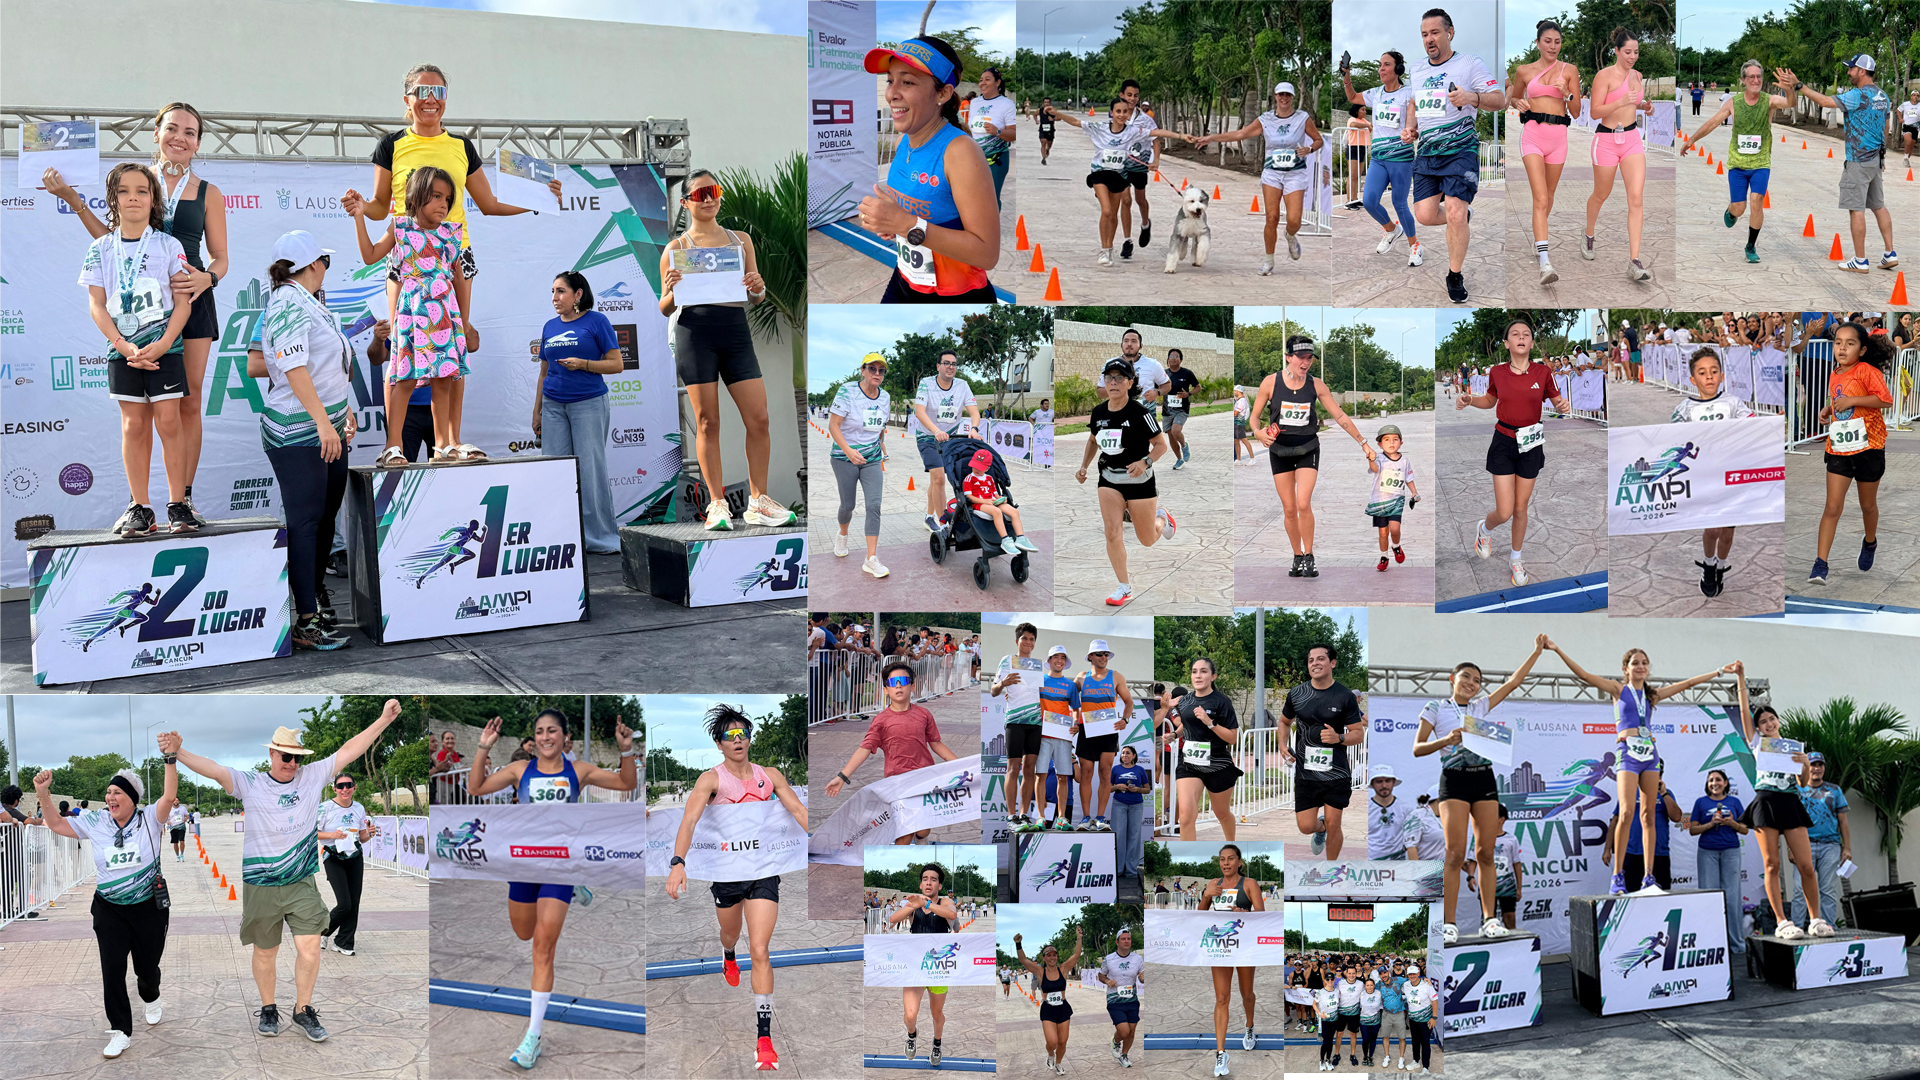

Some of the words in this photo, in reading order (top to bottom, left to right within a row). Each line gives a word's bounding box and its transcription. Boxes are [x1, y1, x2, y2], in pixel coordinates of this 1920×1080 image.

[819, 32, 846, 46] Evalor
[819, 45, 865, 60] Patrimonio
[1419, 98, 1442, 109] 048
[812, 99, 853, 125] 93
[1379, 111, 1396, 121] 047
[55, 127, 69, 147] 2
[818, 128, 852, 139] NOTARÍA
[820, 140, 851, 149] PÚBLICA
[1740, 141, 1758, 150] 258
[1105, 153, 1123, 164] 308
[1276, 153, 1292, 163] 310
[529, 162, 535, 178] 1
[560, 196, 600, 211] LIVE
[705, 253, 717, 270] 3
[132, 291, 153, 313] 21
[79, 355, 107, 365] Evalo
[80, 367, 107, 378] Patri
[81, 379, 107, 389] Inmo
[610, 392, 636, 401] ANCÚN
[867, 417, 883, 426] 316
[1285, 411, 1306, 420] 037
[1522, 431, 1541, 446] 295
[1835, 429, 1860, 443] 301
[1101, 438, 1118, 448] 077
[234, 478, 273, 490] CARRERA
[1386, 477, 1404, 488] 097
[231, 491, 268, 502] INFANTIL
[1615, 479, 1691, 506] AMPI
[230, 501, 253, 511] 500M
[1630, 500, 1677, 513] CANCÚN
[1643, 511, 1665, 520] 2026
[477, 485, 509, 579] 1
[501, 543, 576, 576] LUGAR
[771, 538, 803, 592] 3
[138, 547, 209, 642] 2
[479, 590, 532, 610] AMPI
[198, 607, 267, 636] LUGAR
[153, 642, 204, 660] AMPI
[1027, 660, 1034, 670] 2
[1100, 711, 1107, 719] 3
[1374, 720, 1395, 732] PPG
[1488, 726, 1498, 738] 2
[1527, 722, 1577, 732] LAUSANA
[1691, 724, 1717, 734] LIVE
[1782, 743, 1789, 752] 3
[1186, 749, 1206, 759] 347
[1310, 755, 1328, 765] 142
[535, 788, 566, 801] 360
[922, 785, 972, 807] AMPI
[933, 800, 964, 811] CANCÚN
[275, 821, 306, 833] LAUSANA
[731, 839, 759, 851] LIVE
[766, 838, 800, 852] LAUSANA
[110, 851, 135, 863] 437
[436, 847, 488, 862] AMPI
[524, 849, 567, 857] BANORTE
[586, 848, 605, 859] PPG
[607, 850, 643, 860] Comex
[1065, 843, 1083, 888] 1
[1076, 874, 1113, 888] LUGAR
[1345, 869, 1395, 881] AMPI
[1534, 879, 1562, 889] 2026
[1214, 894, 1233, 904] 090
[1523, 899, 1553, 914] 2.5K
[1200, 938, 1239, 949] AMPI
[1662, 908, 1682, 971] 1
[1678, 947, 1725, 970] LUGAR
[1846, 943, 1866, 978] 3
[921, 960, 957, 970] AMPI
[1862, 965, 1883, 977] LUGAR
[1444, 950, 1490, 1015] 2
[1663, 978, 1697, 993] AMPI
[1481, 990, 1527, 1011] LUGAR
[1452, 1015, 1486, 1028] AMPI
